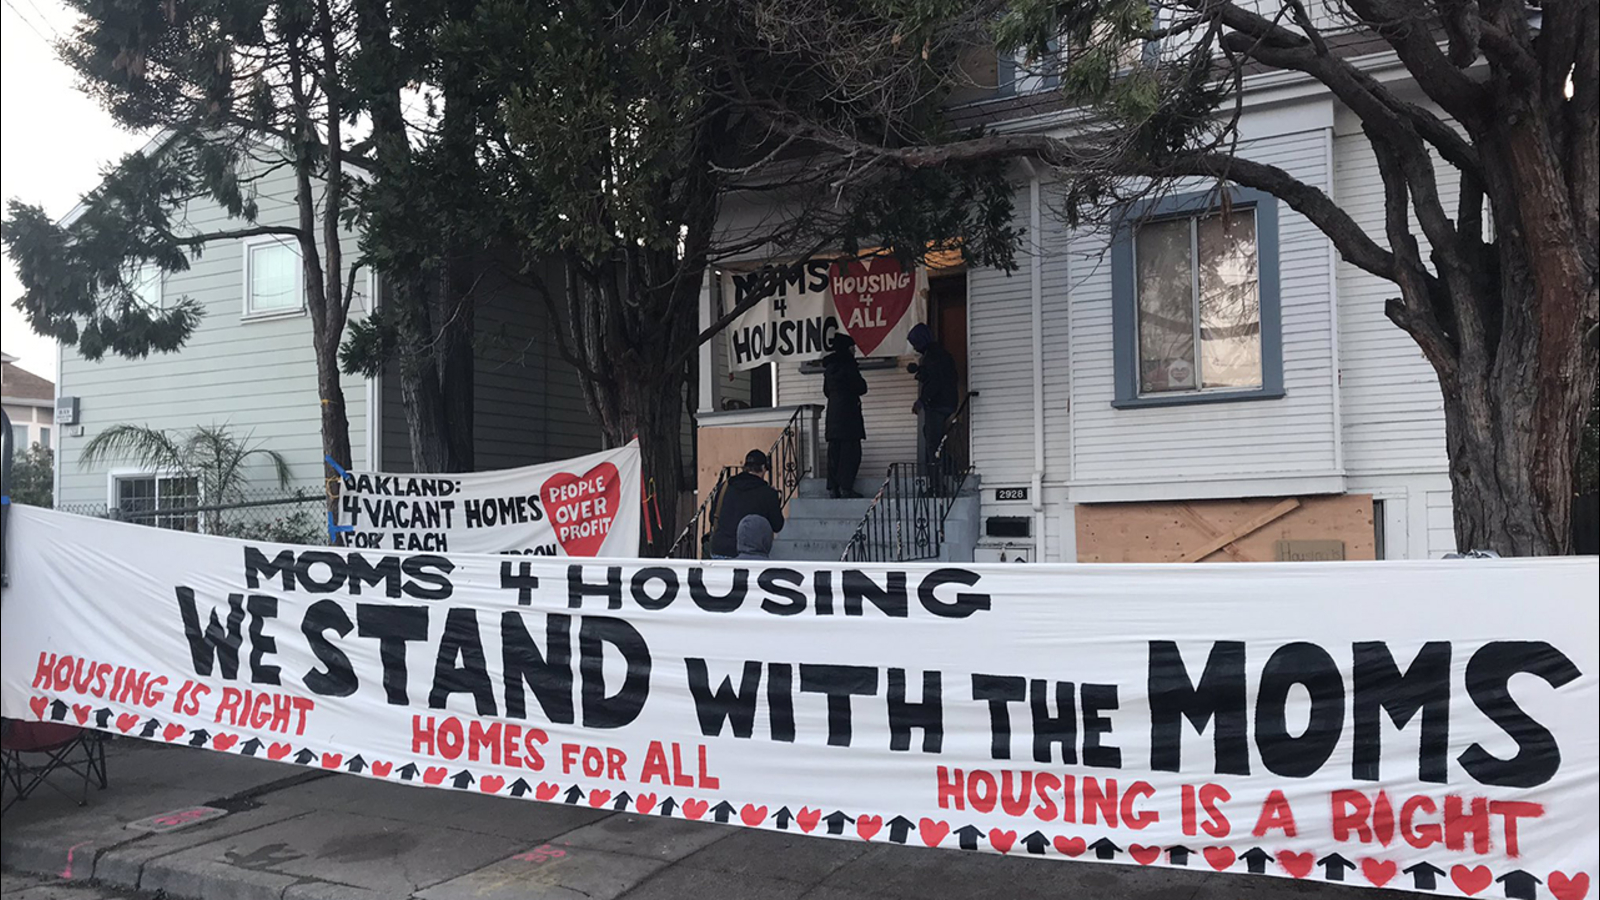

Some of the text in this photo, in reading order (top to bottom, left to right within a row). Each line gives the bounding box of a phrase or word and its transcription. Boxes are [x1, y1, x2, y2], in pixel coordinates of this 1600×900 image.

[833, 272, 910, 295] HOUSING
[773, 298, 787, 317] 4
[860, 294, 873, 306] 4
[848, 307, 887, 328] ALL
[733, 316, 838, 364] HOUSING
[342, 472, 461, 496] OAKLAND:
[549, 476, 606, 503] PEOPLE
[999, 489, 1023, 499] 2928
[343, 495, 543, 529] 4 VACANT HOMES
[556, 497, 607, 524] OVER
[344, 531, 447, 552] FOR EACH
[560, 517, 612, 542] PROFIT
[245, 546, 991, 618] MOMS 4 HOUSING
[32, 651, 314, 735] HOUSING IS RIGHT
[175, 586, 1582, 787] WE STAND WITH THE MOMS
[411, 715, 720, 789] HOMES FOR ALL
[937, 765, 1545, 858] HOUSING IS A RIGHT
